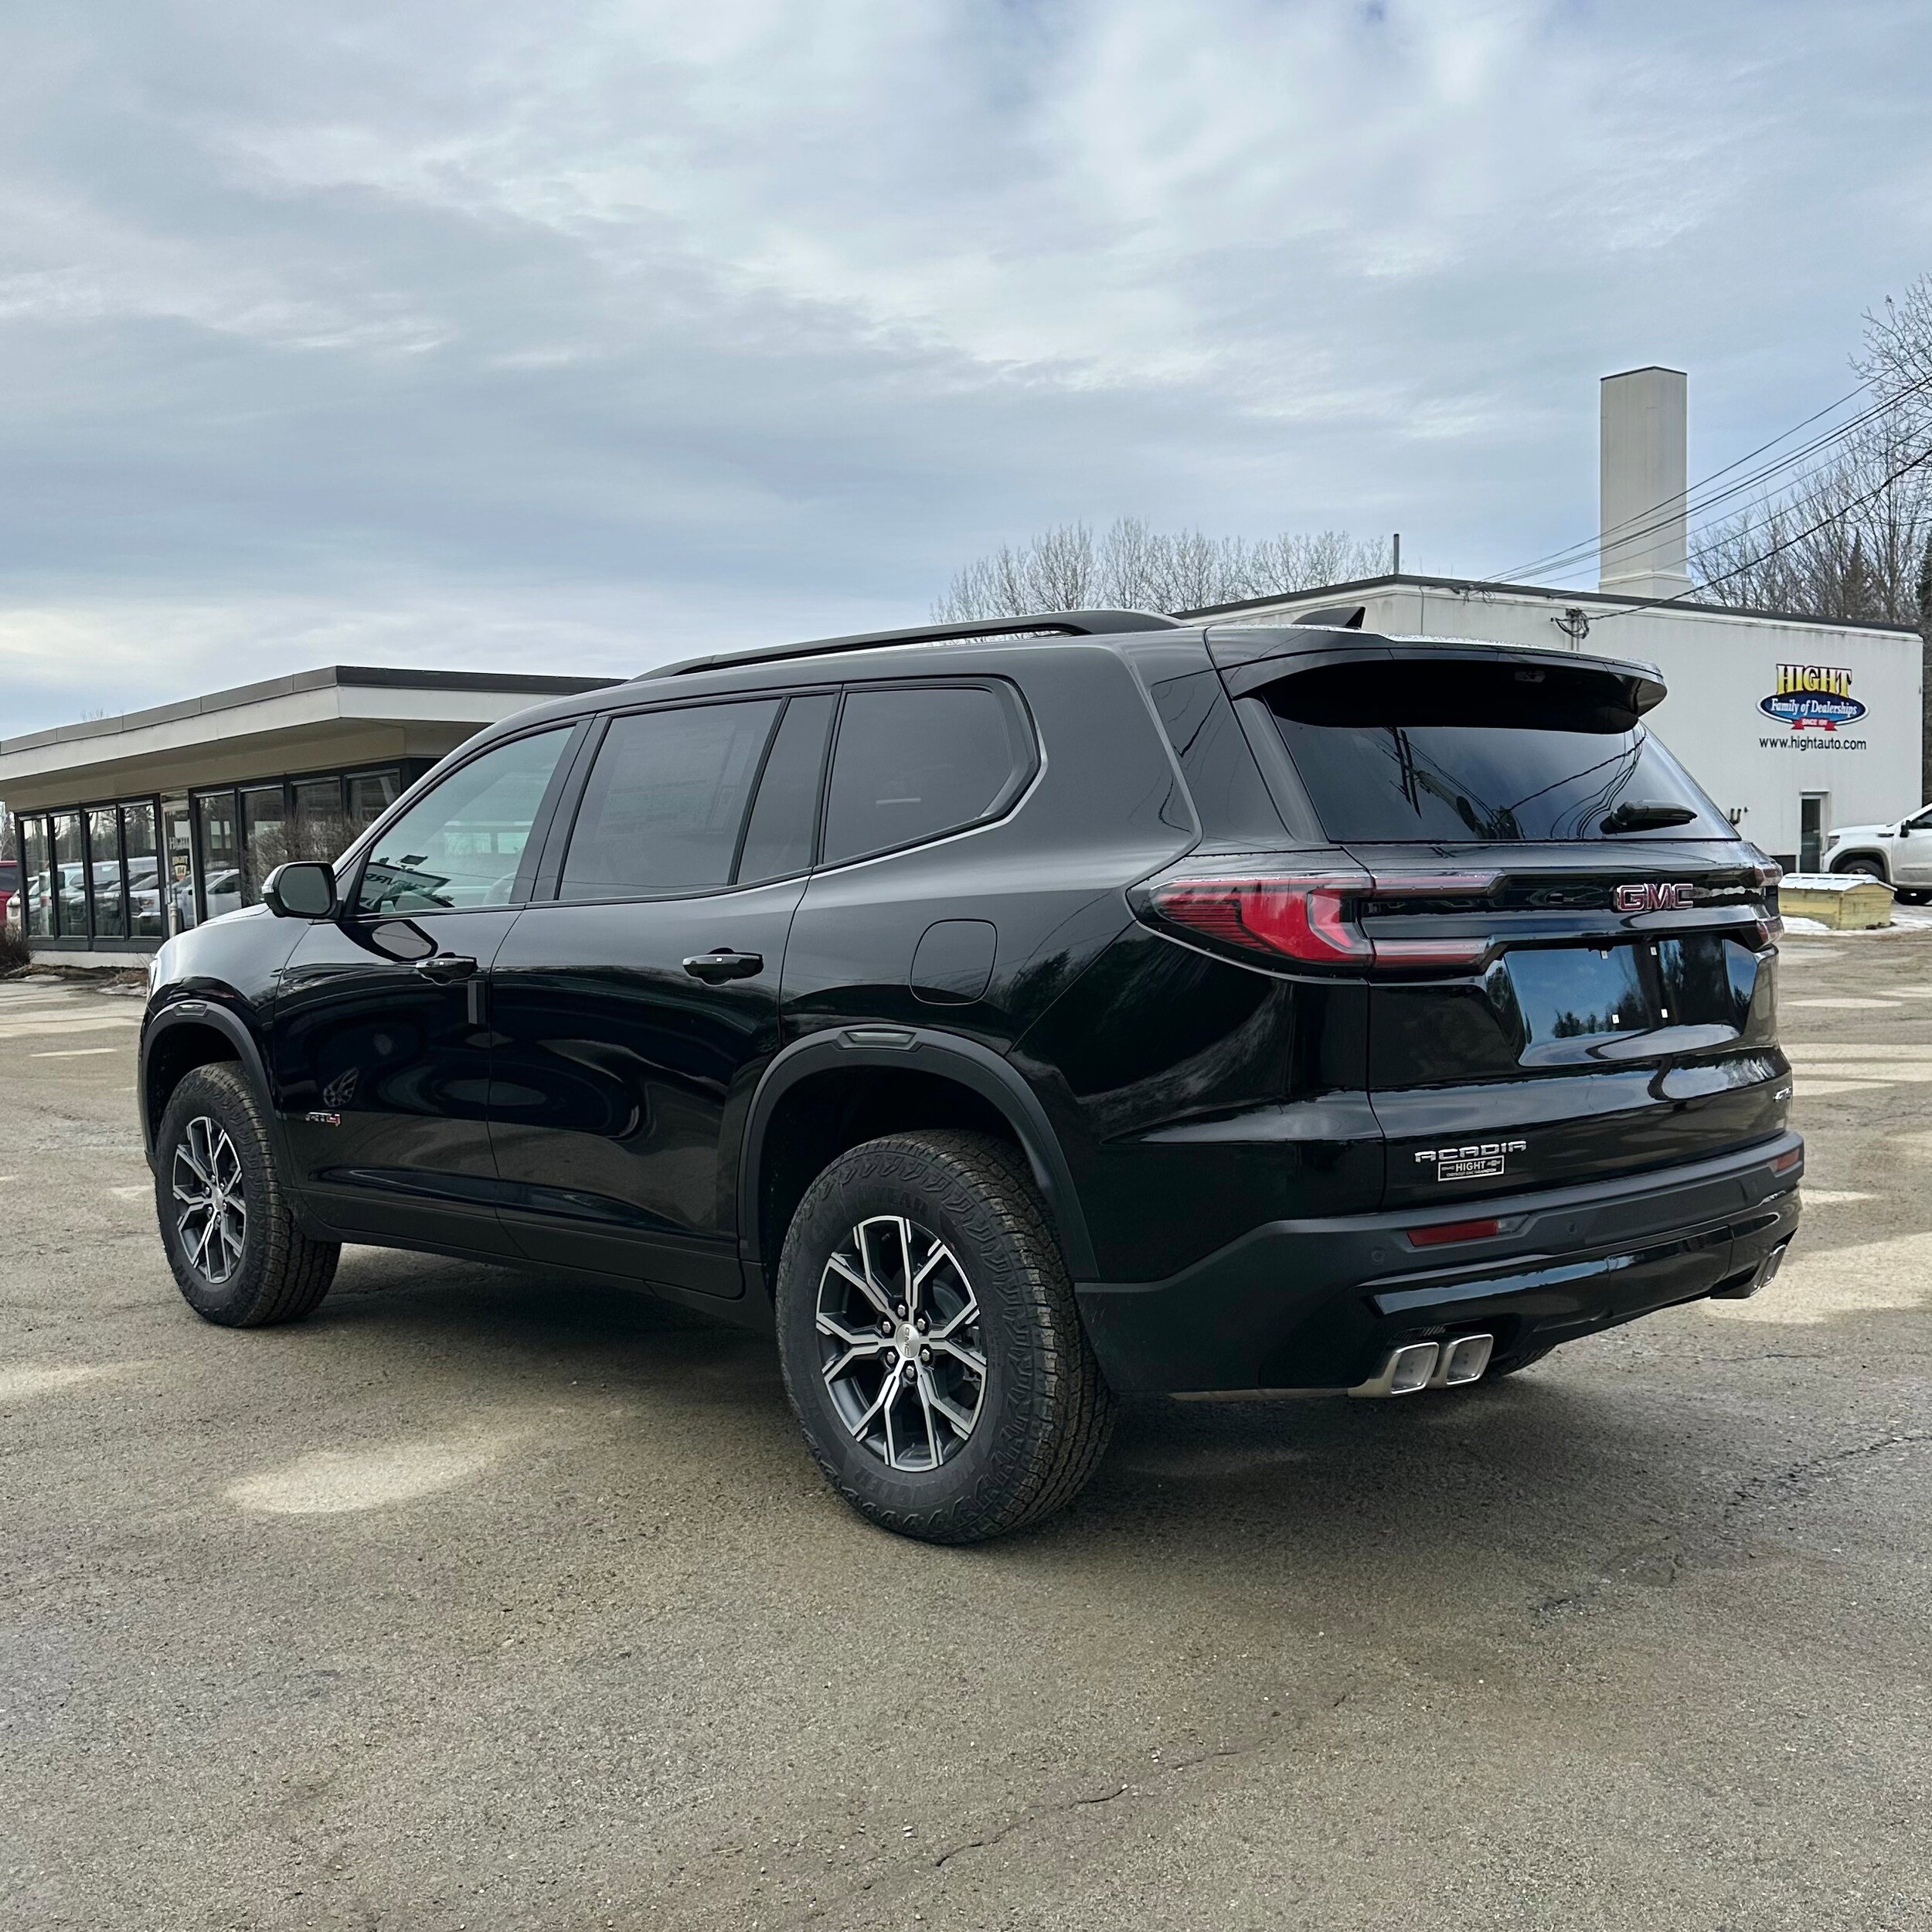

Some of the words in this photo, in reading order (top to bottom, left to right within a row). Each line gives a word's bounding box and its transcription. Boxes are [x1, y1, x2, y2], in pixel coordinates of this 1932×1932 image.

[1776, 664, 1852, 698] HIGHT
[1771, 699, 1799, 716] Family
[1801, 700, 1811, 716] of
[1811, 700, 1858, 717] Dealerships
[1759, 736, 1867, 751] www.hightauto.com
[1616, 883, 1694, 910] GMC
[1414, 1140, 1527, 1163] ACADIA
[1456, 1161, 1486, 1172] HIGHT
